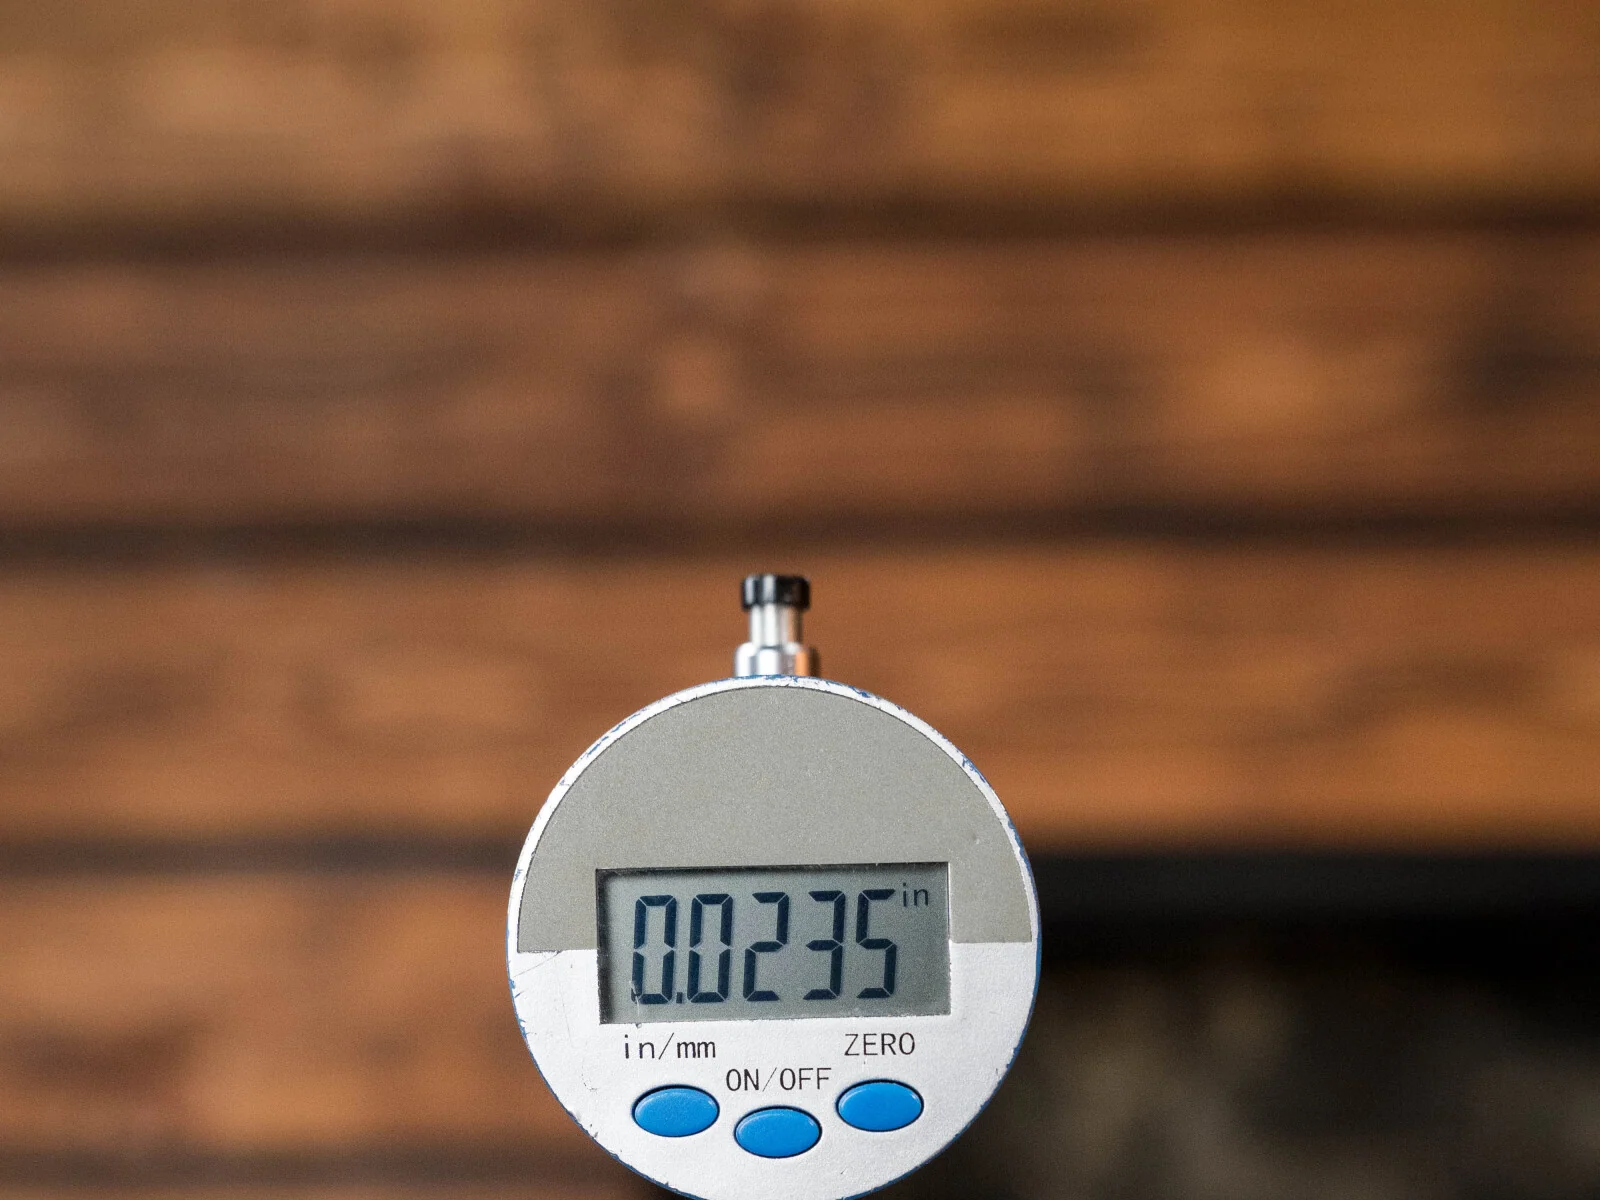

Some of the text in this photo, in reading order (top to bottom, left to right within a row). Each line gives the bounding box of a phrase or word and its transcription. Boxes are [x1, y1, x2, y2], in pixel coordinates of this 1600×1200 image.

[630, 882, 929, 1004] 0.0235 in
[624, 1032, 716, 1060] in/mm
[844, 1032, 916, 1056] ZERO
[725, 1067, 832, 1092] ON/OFF
